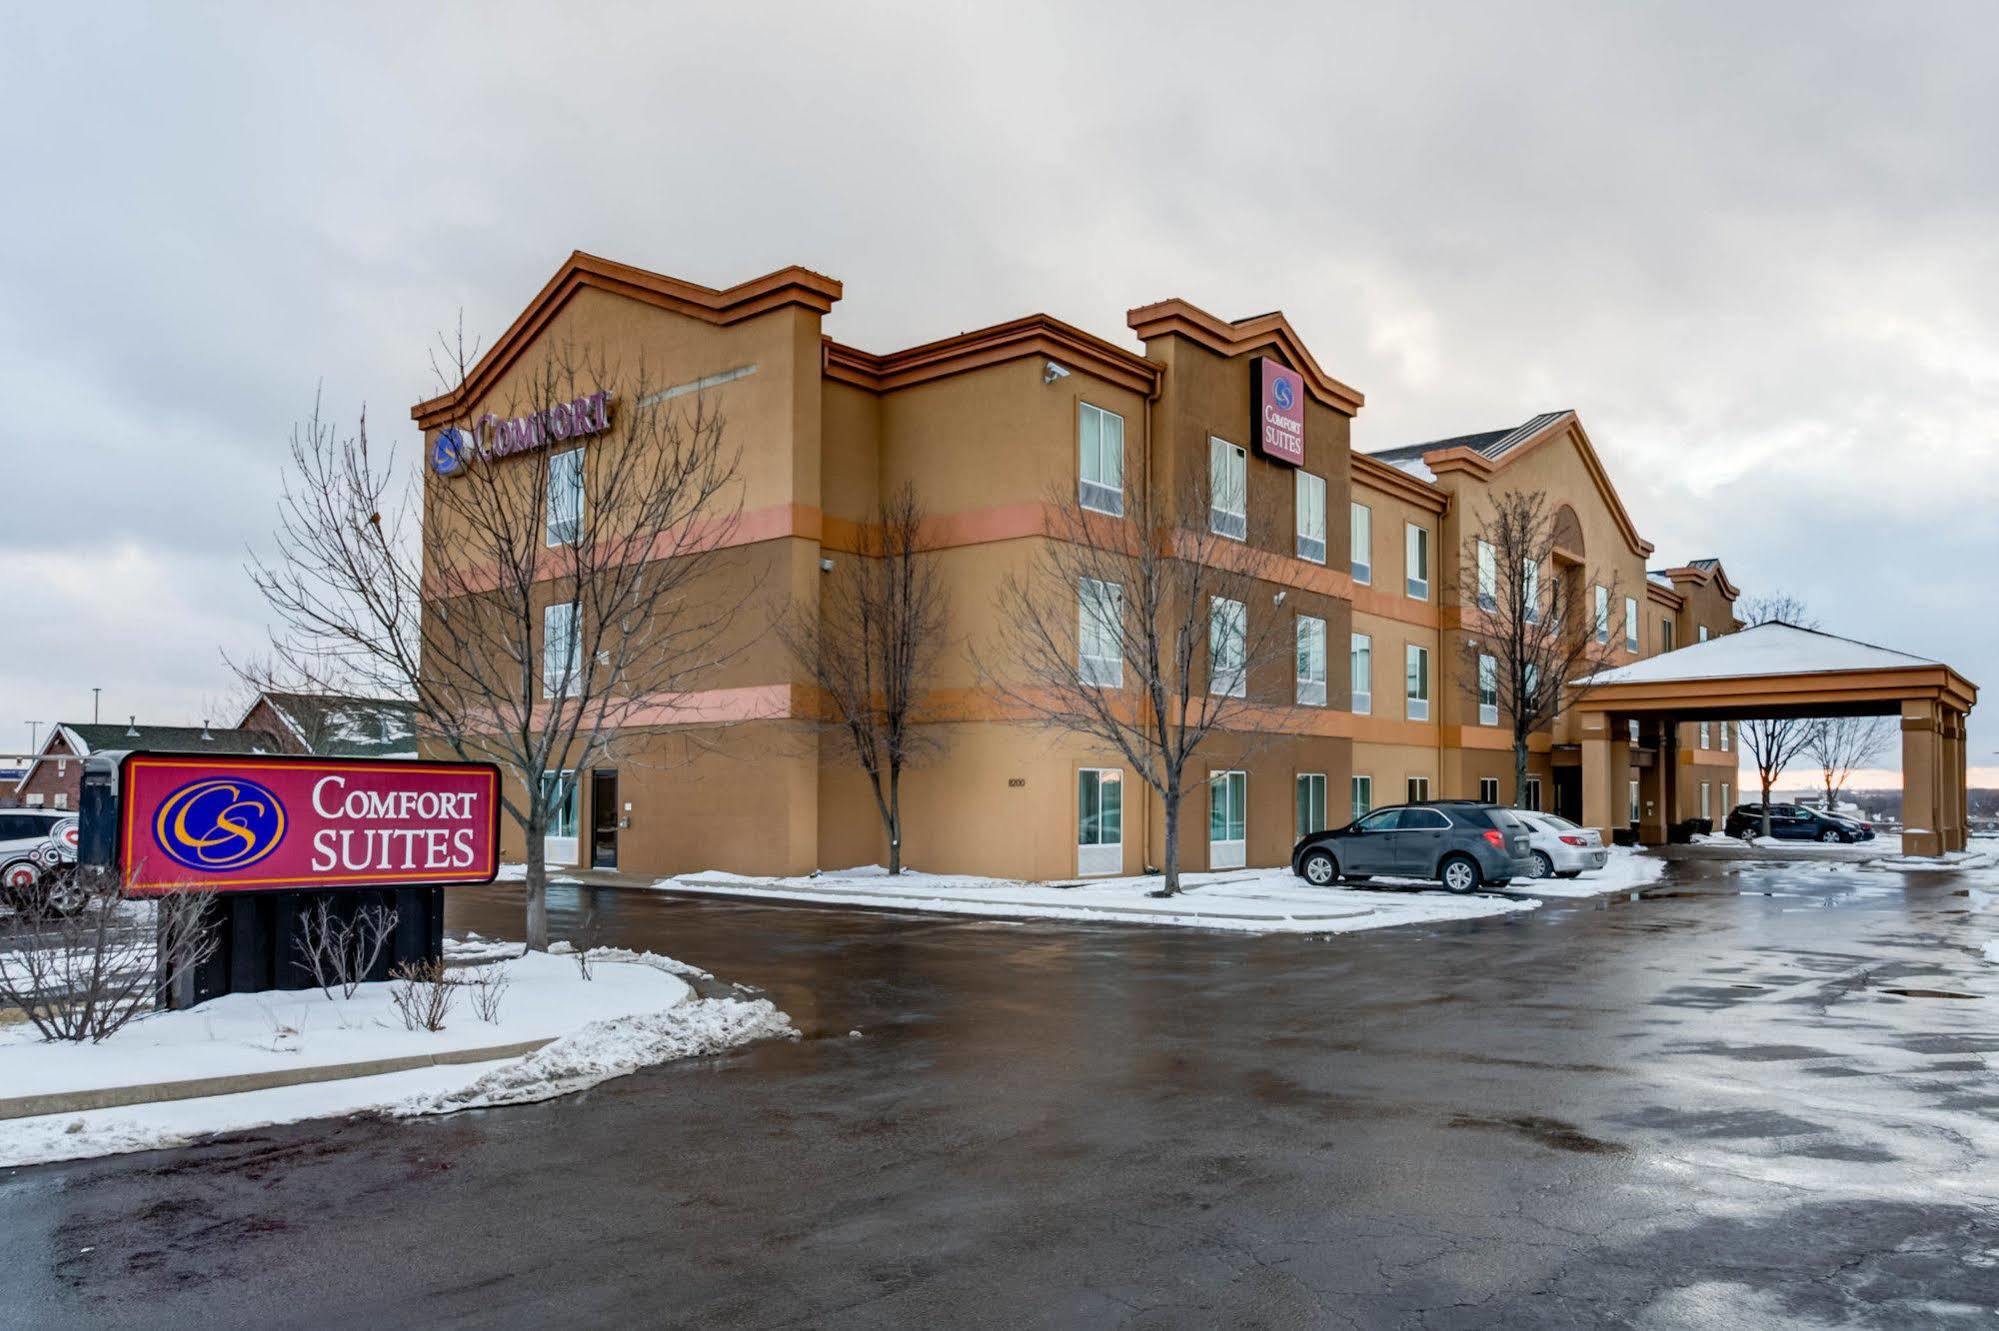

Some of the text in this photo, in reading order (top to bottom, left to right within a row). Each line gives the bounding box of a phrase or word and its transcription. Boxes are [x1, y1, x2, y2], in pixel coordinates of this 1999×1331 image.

[474, 391, 610, 460] COMFORT
[1265, 405, 1301, 434] COMFORT
[1265, 426, 1301, 454] SUITES
[312, 776, 477, 819] COMFORT
[311, 830, 474, 871] SUITES
